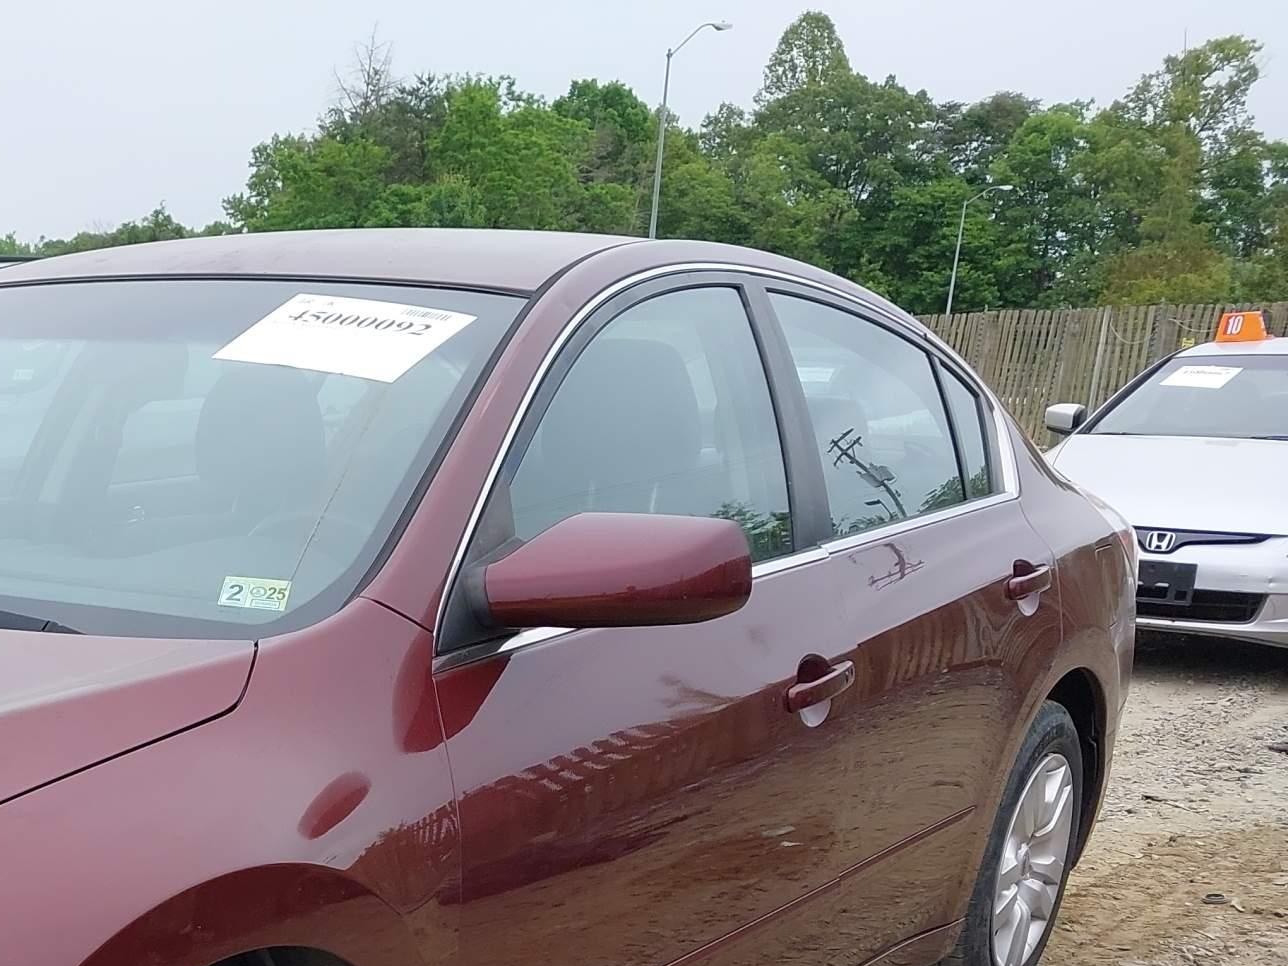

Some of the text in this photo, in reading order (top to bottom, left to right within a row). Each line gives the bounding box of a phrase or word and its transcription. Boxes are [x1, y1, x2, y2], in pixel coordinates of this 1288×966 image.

[287, 309, 433, 336] 45000092
[1226, 315, 1245, 335] 10
[224, 584, 288, 602] 2 25
